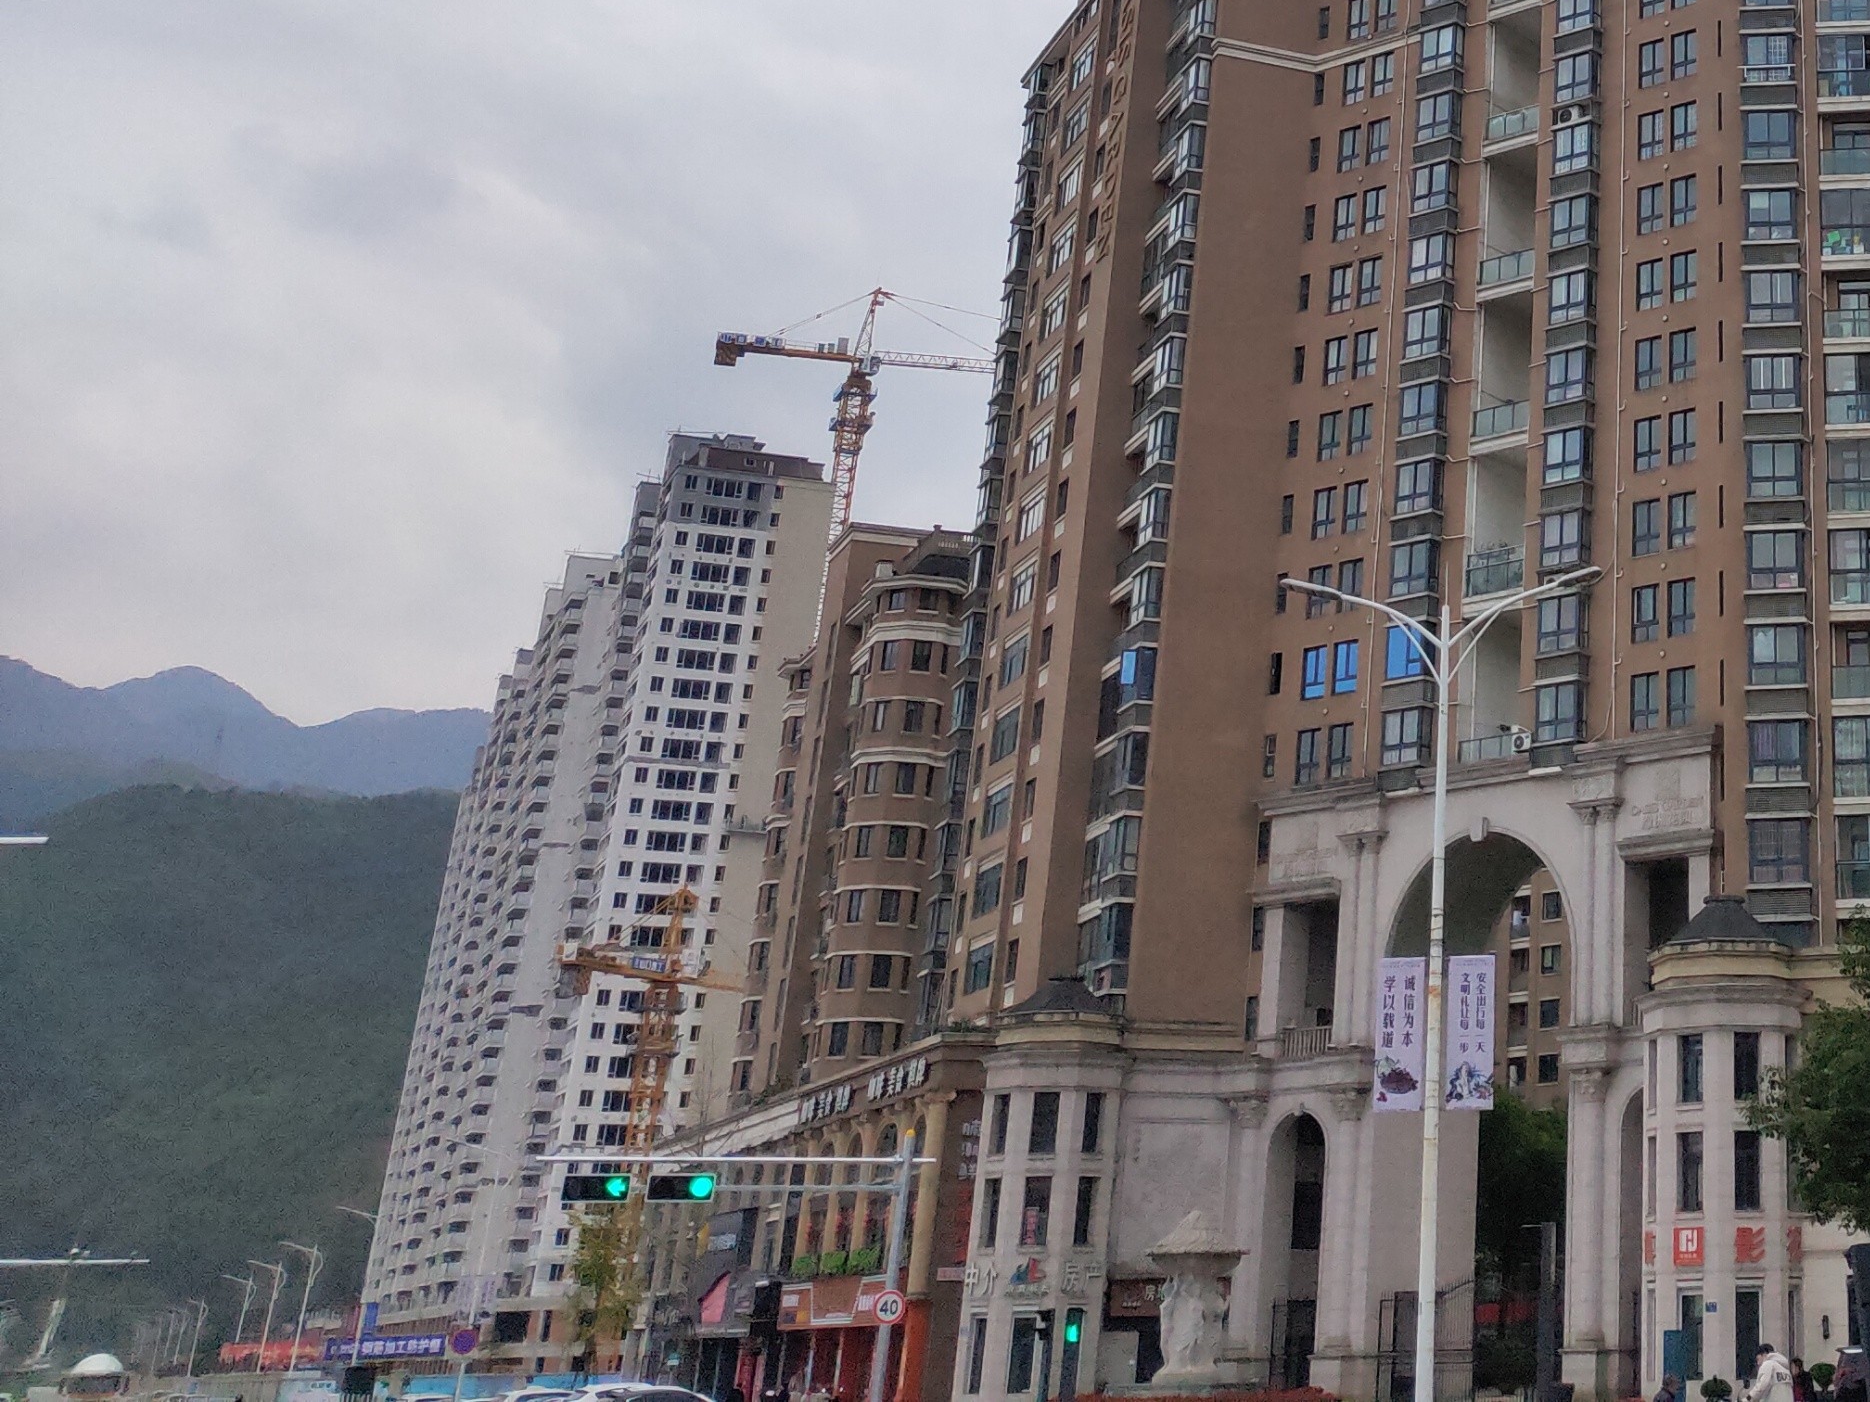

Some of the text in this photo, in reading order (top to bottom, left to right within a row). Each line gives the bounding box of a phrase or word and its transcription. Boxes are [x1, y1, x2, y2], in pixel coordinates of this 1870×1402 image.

[1095, 72, 1128, 264] GARDEN
[1401, 975, 1416, 1047] 诚信为本
[1459, 972, 1470, 1053] 文明礼让每一步
[1475, 972, 1487, 1053] 安全出行每一天
[879, 1299, 899, 1315] 40
[965, 1261, 1102, 1297] 中介 房产
